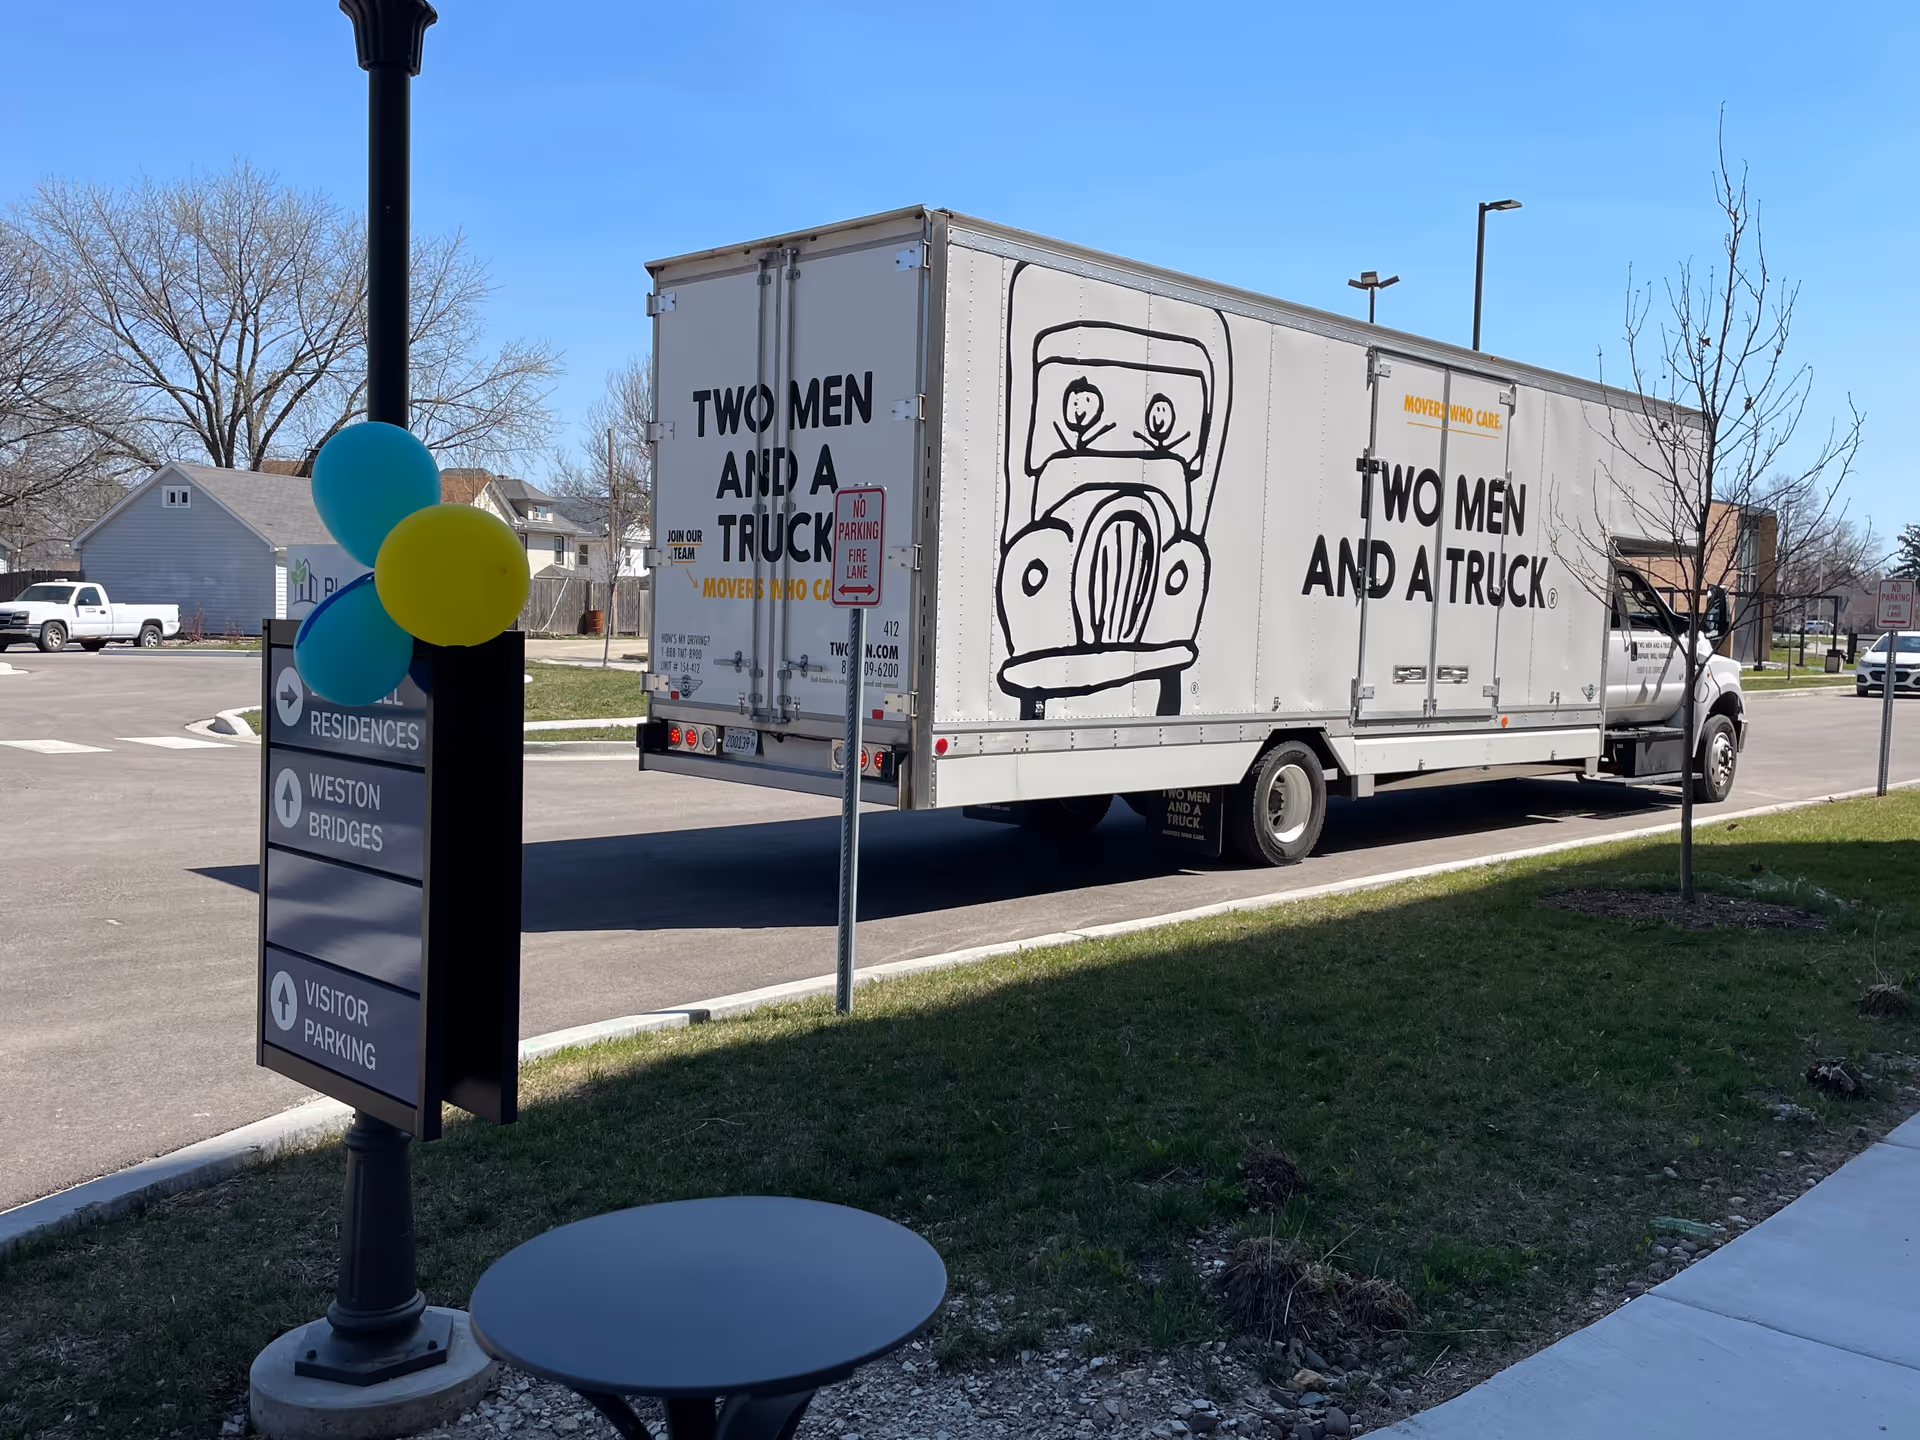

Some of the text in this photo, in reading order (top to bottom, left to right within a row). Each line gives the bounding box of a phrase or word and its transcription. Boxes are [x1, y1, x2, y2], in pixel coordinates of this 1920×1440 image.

[693, 370, 873, 437] TWO MEN
[1404, 394, 1446, 419] MOVERS
[1449, 404, 1473, 424] WHO
[716, 444, 838, 499] AND A
[1356, 457, 1526, 536] TWO MEN
[853, 499, 866, 518] NO
[667, 530, 702, 543] JOIN OUR
[718, 512, 834, 563] TRUCK
[838, 521, 879, 541] PARKING
[674, 547, 695, 559] TEAM
[848, 548, 867, 562] FIRE
[846, 565, 867, 579] LANE
[1302, 534, 1396, 600] AND
[1405, 544, 1433, 602] A
[702, 577, 831, 600] MOVERS WHO CA
[1881, 593, 1911, 602] PARKING
[1892, 584, 1902, 592] NO
[883, 621, 899, 637] 412
[679, 634, 686, 645] MY
[830, 642, 899, 660] TWON.COM
[310, 710, 420, 751] RESIDENCES
[726, 735, 750, 750] 200139
[309, 772, 381, 810] WESTON
[1162, 788, 1210, 804] TWO MEN
[1168, 801, 1201, 816] AND A
[309, 811, 383, 852] BRIDGES
[304, 979, 369, 1027] VISITOR
[304, 1018, 376, 1071] PARKING
